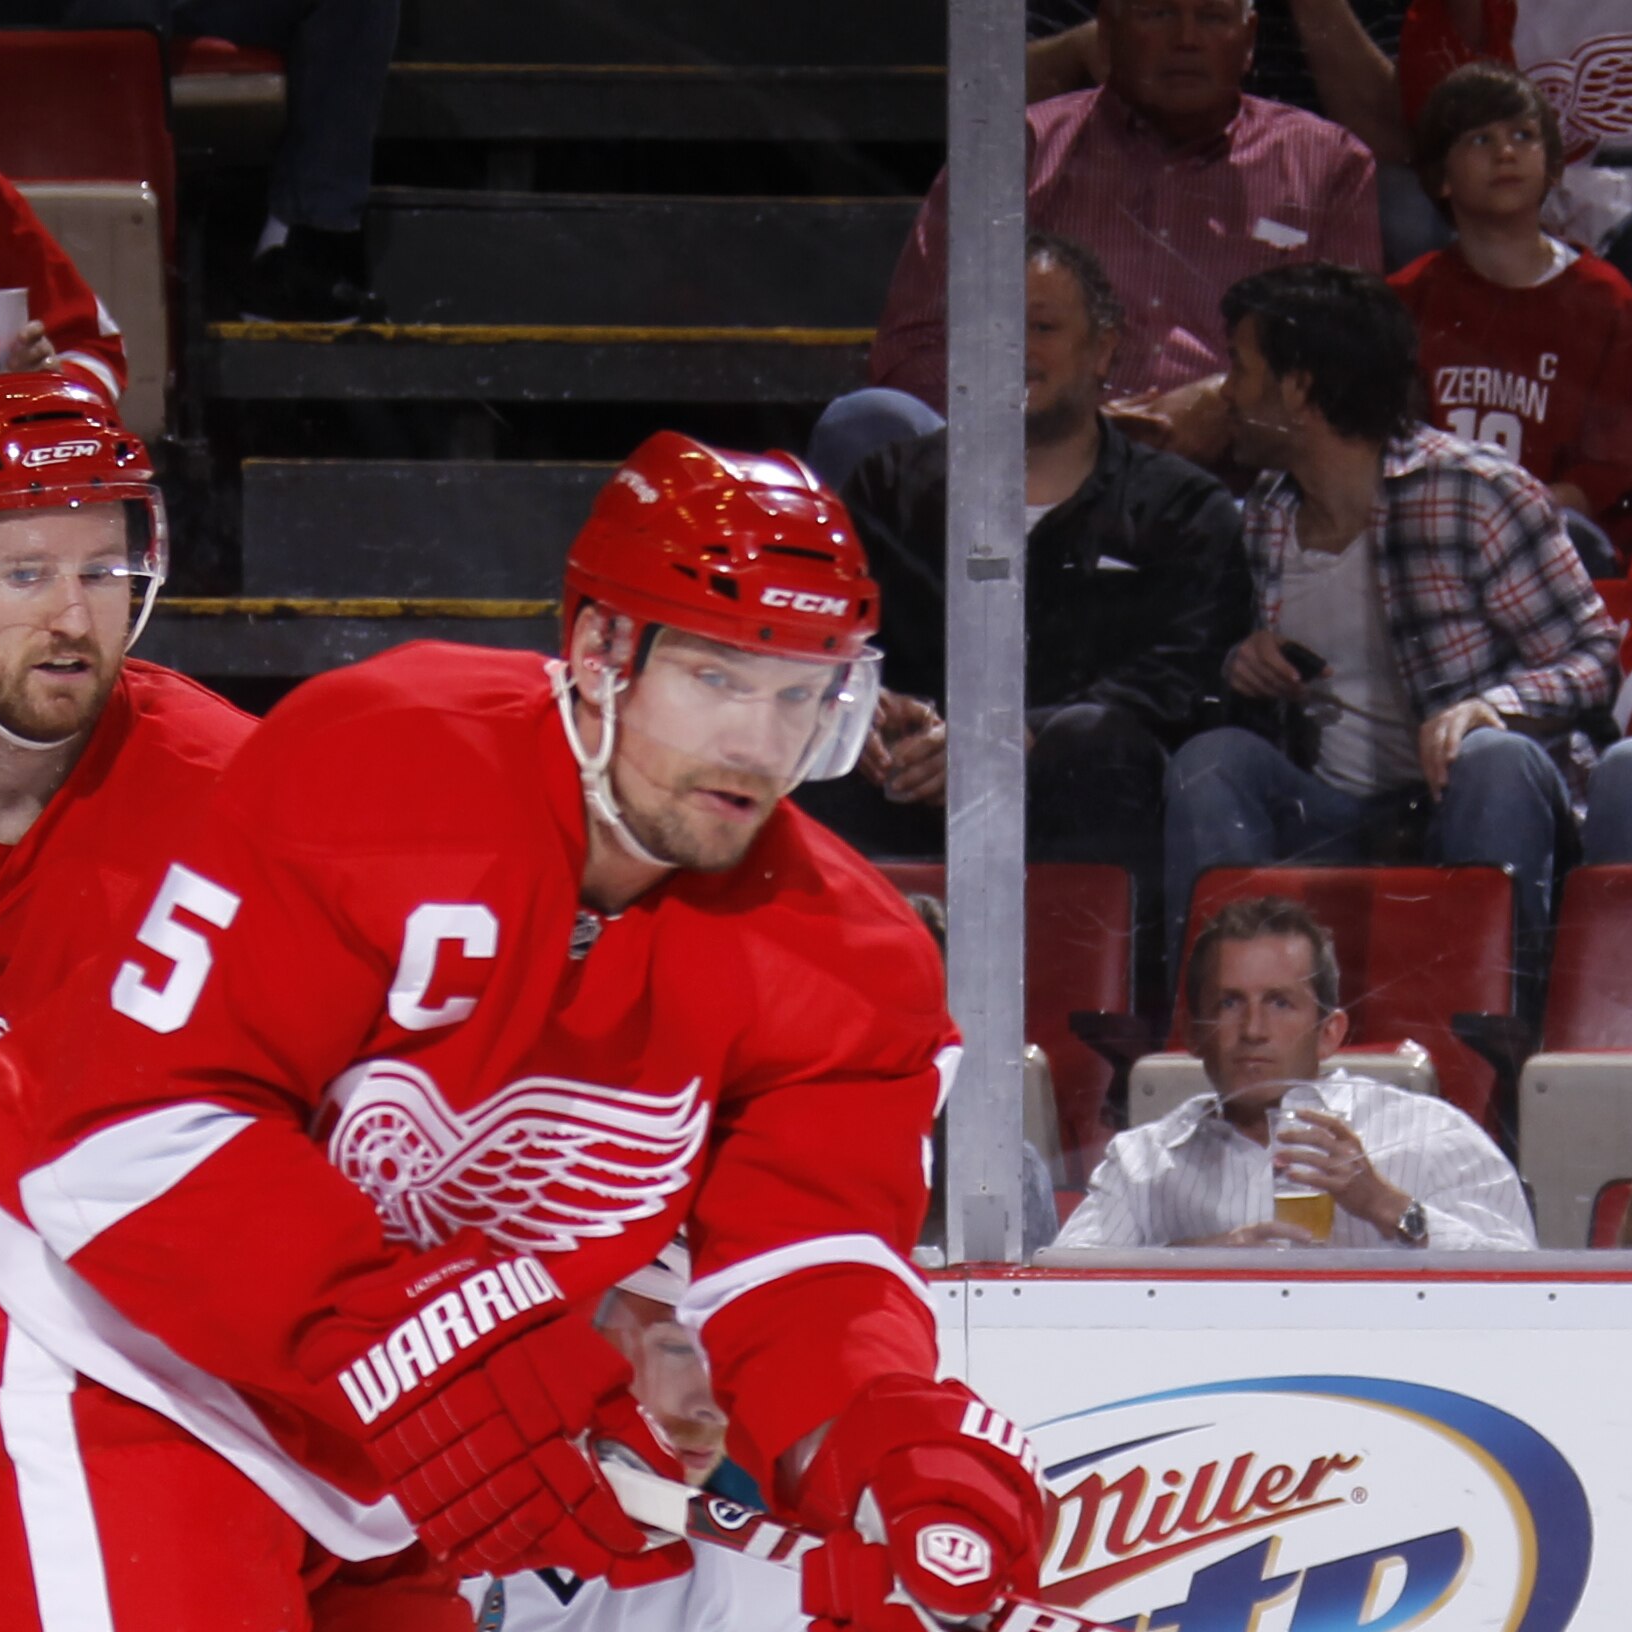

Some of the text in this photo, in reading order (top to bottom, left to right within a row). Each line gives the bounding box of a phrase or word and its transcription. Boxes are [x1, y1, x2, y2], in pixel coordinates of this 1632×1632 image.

[1433, 366, 1549, 423] ZERMAN
[1539, 352, 1558, 380] C
[30, 445, 95, 463] CCM
[760, 587, 849, 616] CCM
[111, 863, 242, 1034] 5
[388, 904, 499, 1031] C
[337, 1255, 566, 1426] WARRIO
[1040, 1448, 1364, 1573] Miller
